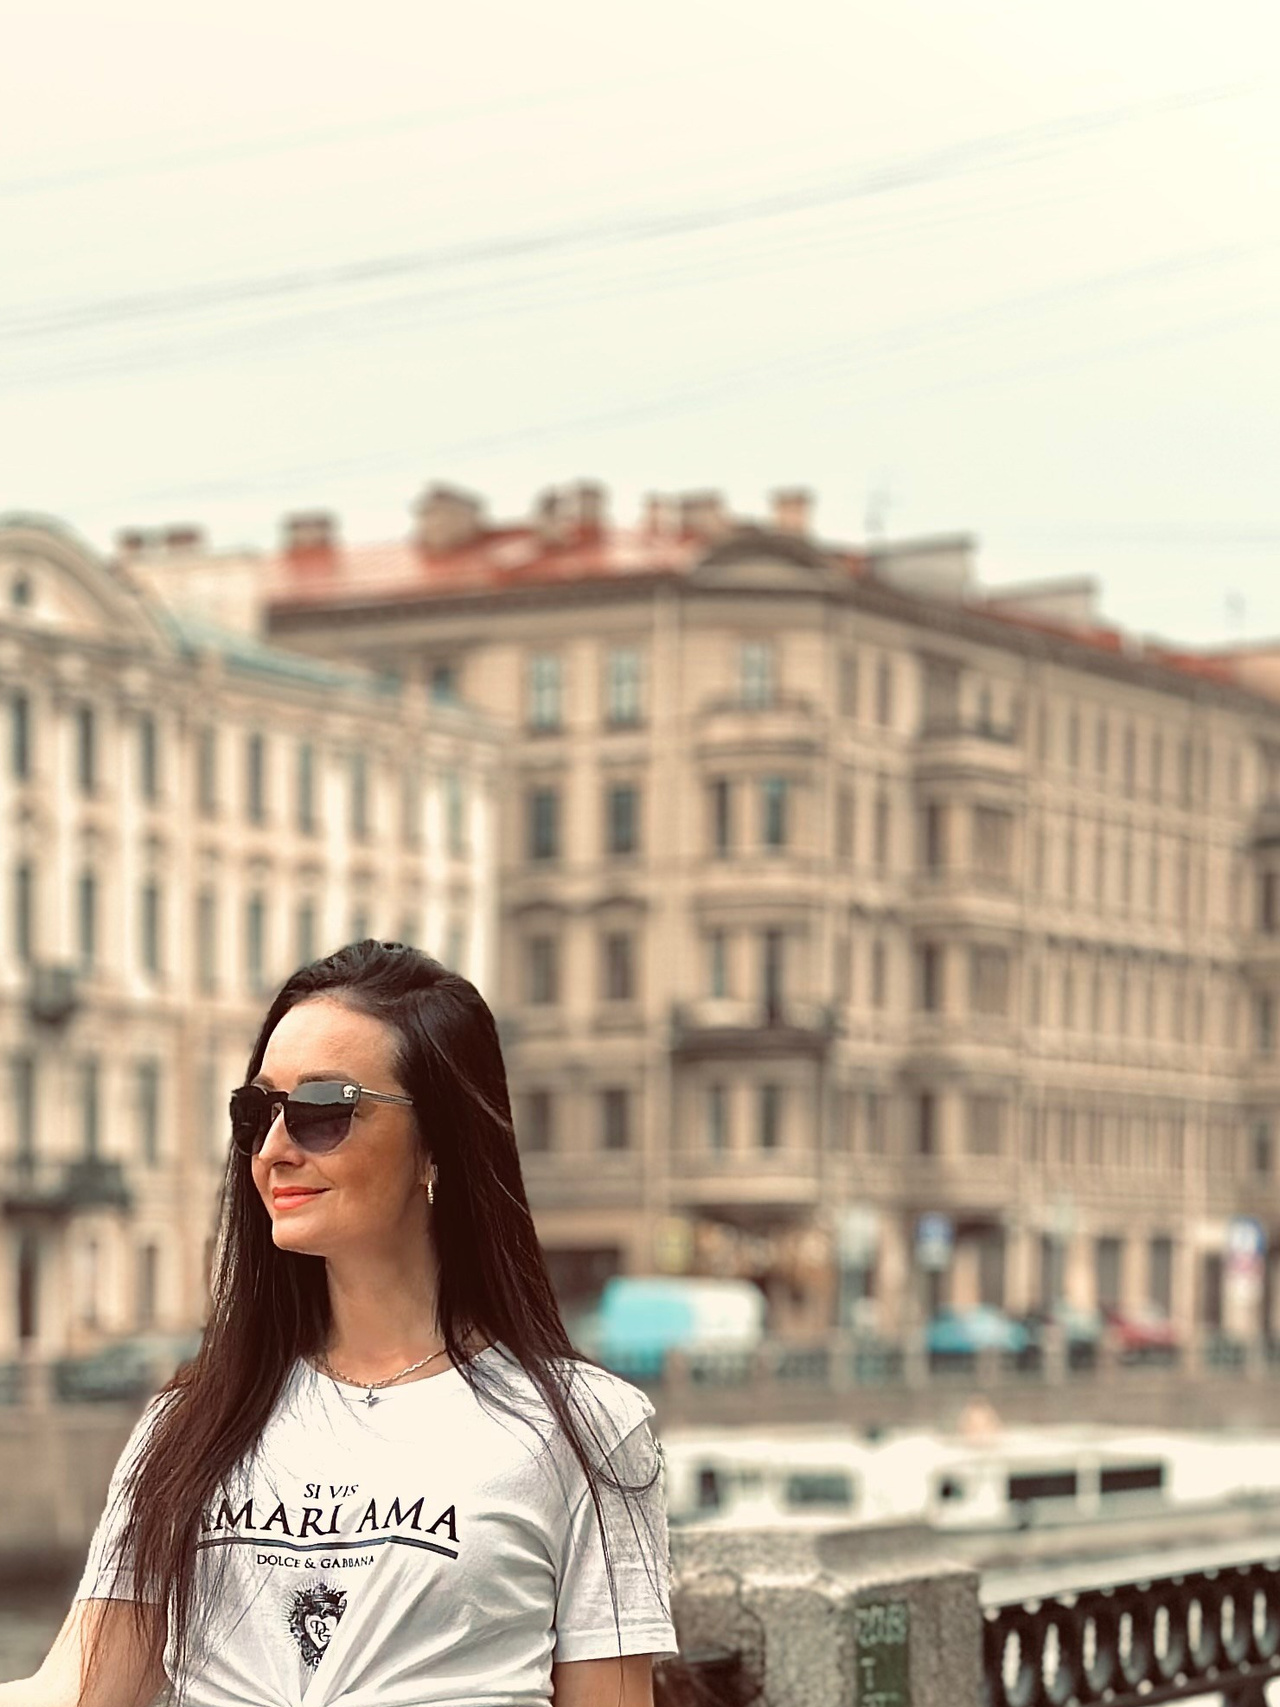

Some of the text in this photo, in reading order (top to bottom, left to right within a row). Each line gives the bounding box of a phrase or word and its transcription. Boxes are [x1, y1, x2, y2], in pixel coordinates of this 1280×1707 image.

[304, 1483, 359, 1499] SI VIS
[200, 1496, 460, 1543] MARI AMA
[256, 1554, 374, 1570] DOLCE & GABBANA
